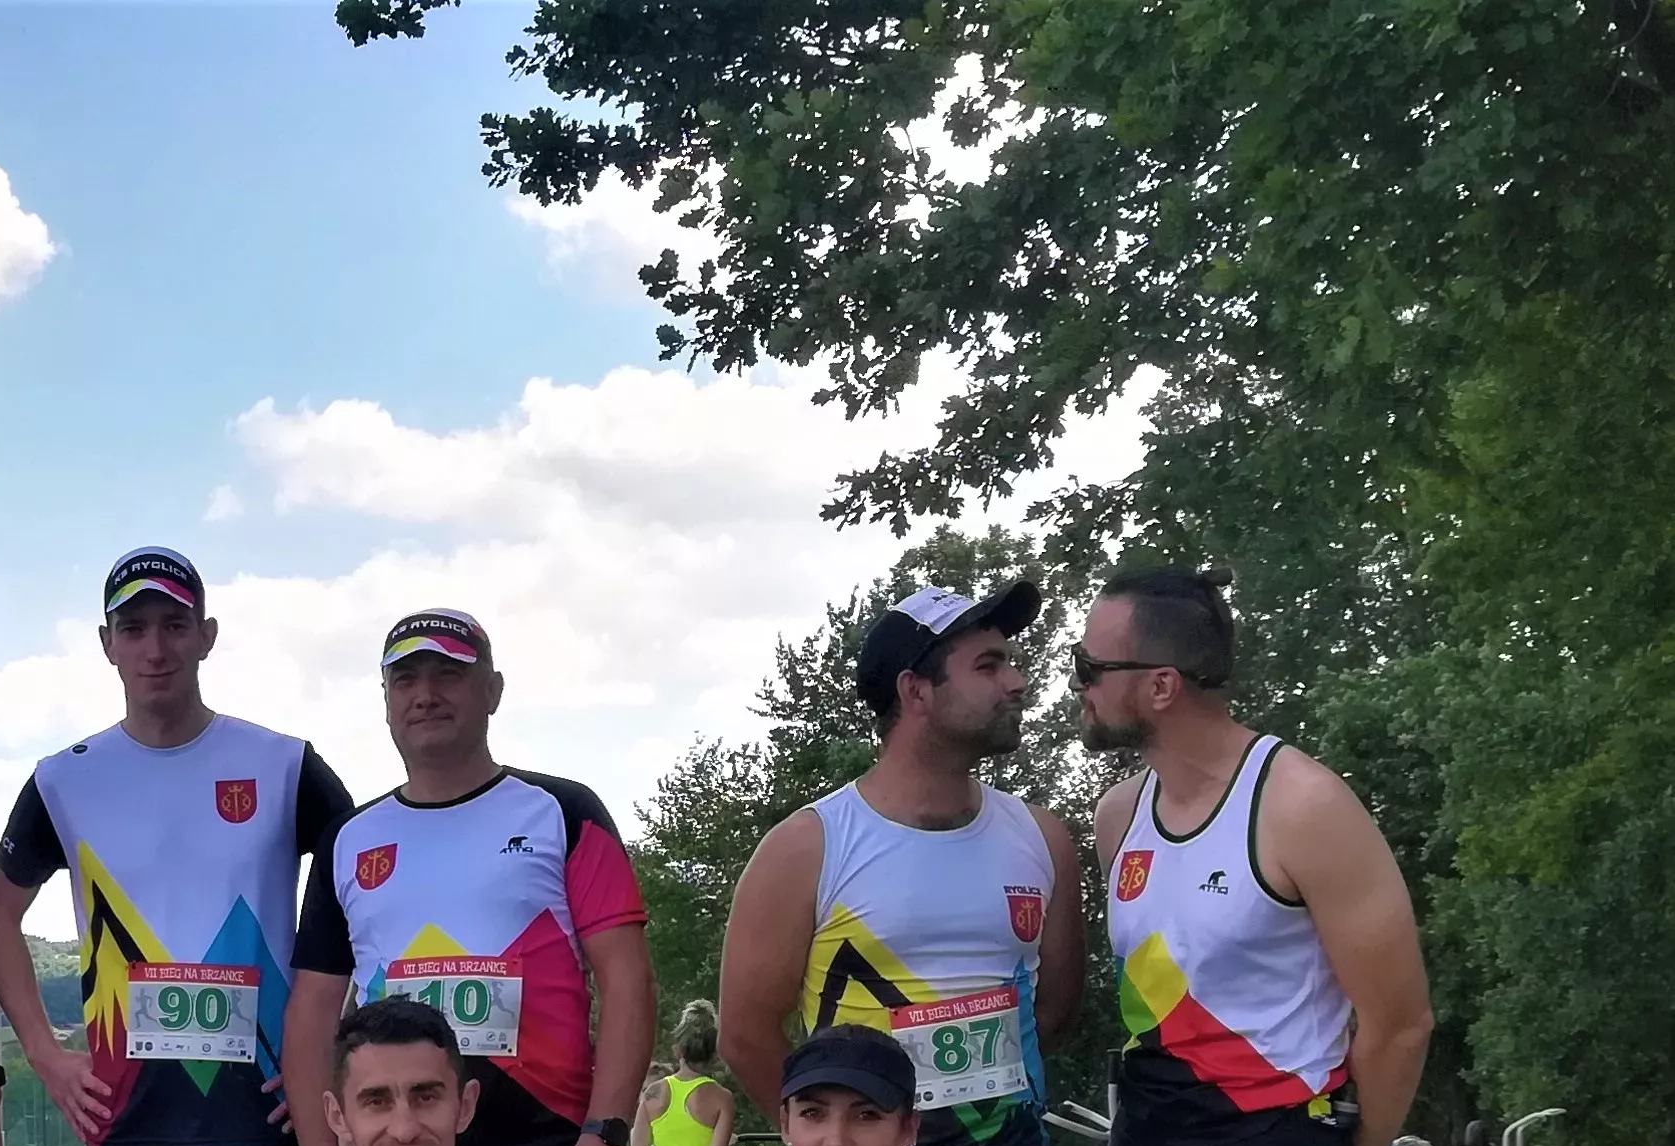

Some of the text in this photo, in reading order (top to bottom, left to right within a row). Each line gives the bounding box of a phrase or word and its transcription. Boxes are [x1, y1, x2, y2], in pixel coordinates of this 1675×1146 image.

[131, 560, 189, 581] RYGLICE
[410, 619, 470, 637] RYGLICE
[144, 966, 245, 985] VII BIEG NA BRZANKĘ
[403, 961, 508, 976] VII BIEG NA BRZANKĘ
[157, 985, 231, 1033] 90
[417, 979, 491, 1026] 10
[908, 1010, 925, 1023] VII
[926, 1005, 951, 1020] BIEG
[953, 1002, 968, 1016] NA
[932, 1016, 1003, 1076] 87
